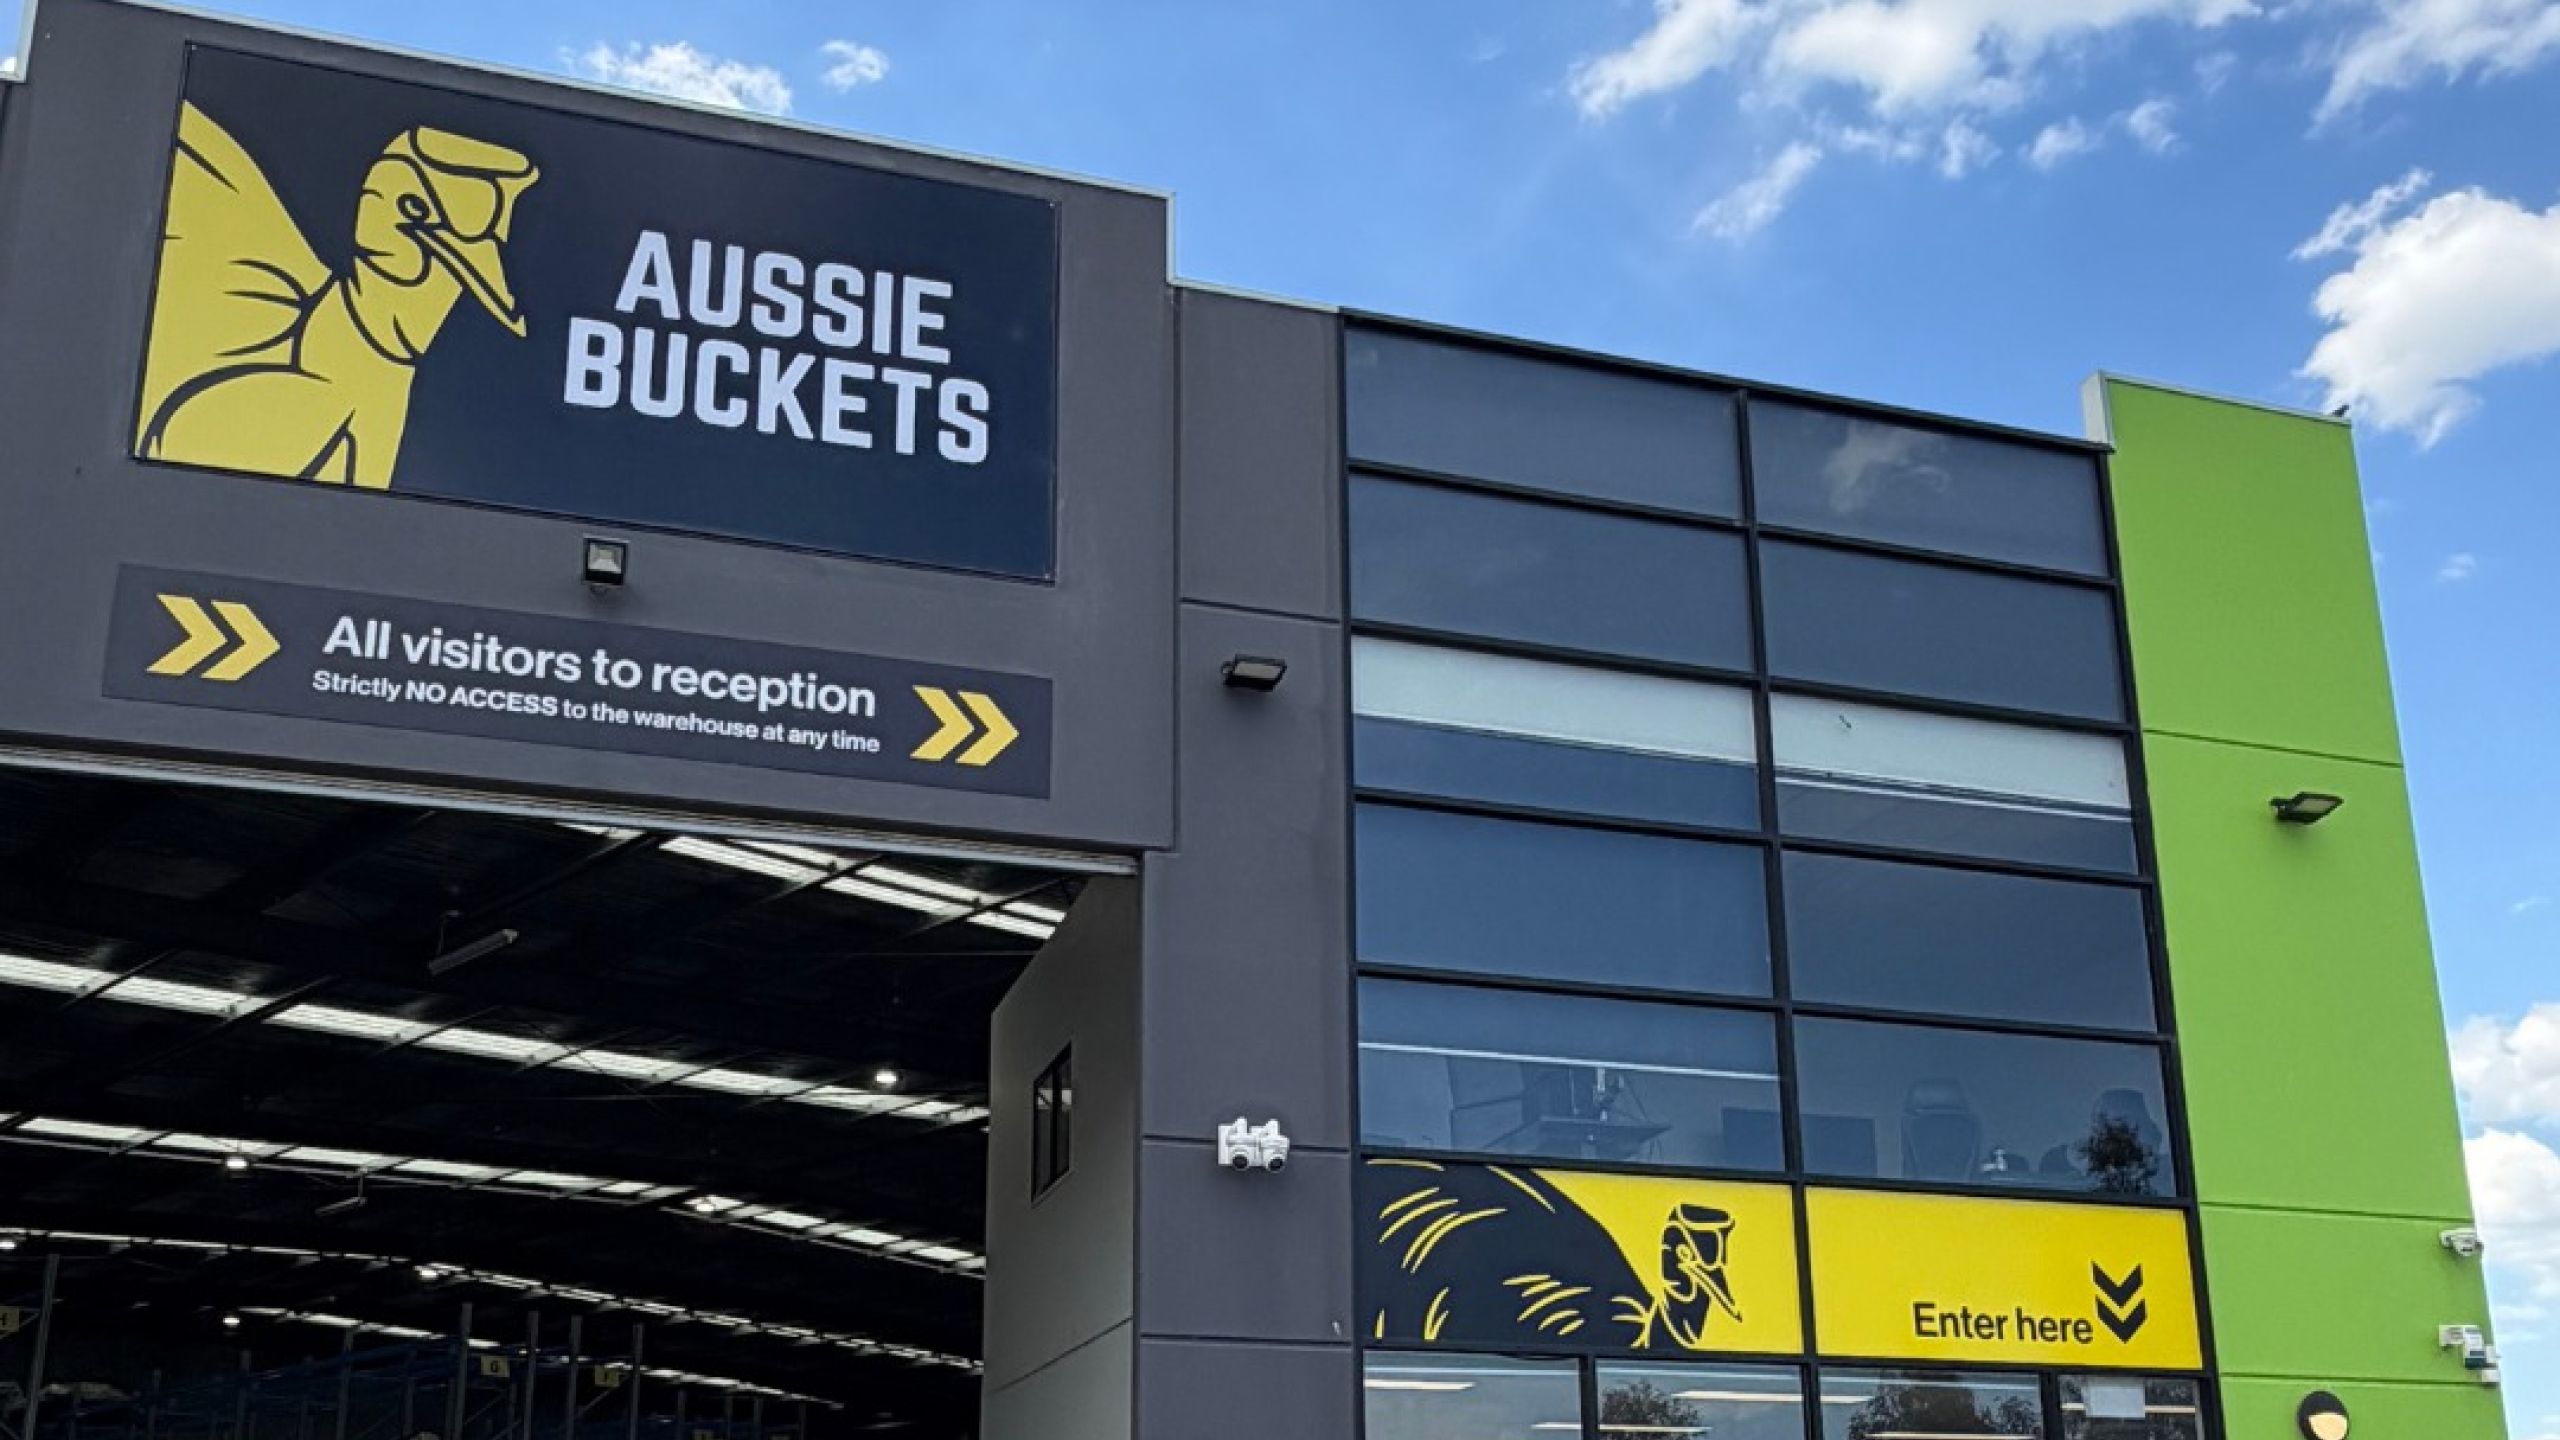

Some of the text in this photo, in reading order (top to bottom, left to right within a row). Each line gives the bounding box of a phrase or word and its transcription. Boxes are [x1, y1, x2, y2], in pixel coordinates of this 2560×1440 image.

[615, 229, 953, 364] AUSSIE
[563, 316, 990, 464] BUCKETS
[312, 670, 881, 753] Strictly NO ACCESS to the warehouse at any time
[322, 615, 876, 718] All visitors to reception
[1912, 1301, 2093, 1345] Enter here
